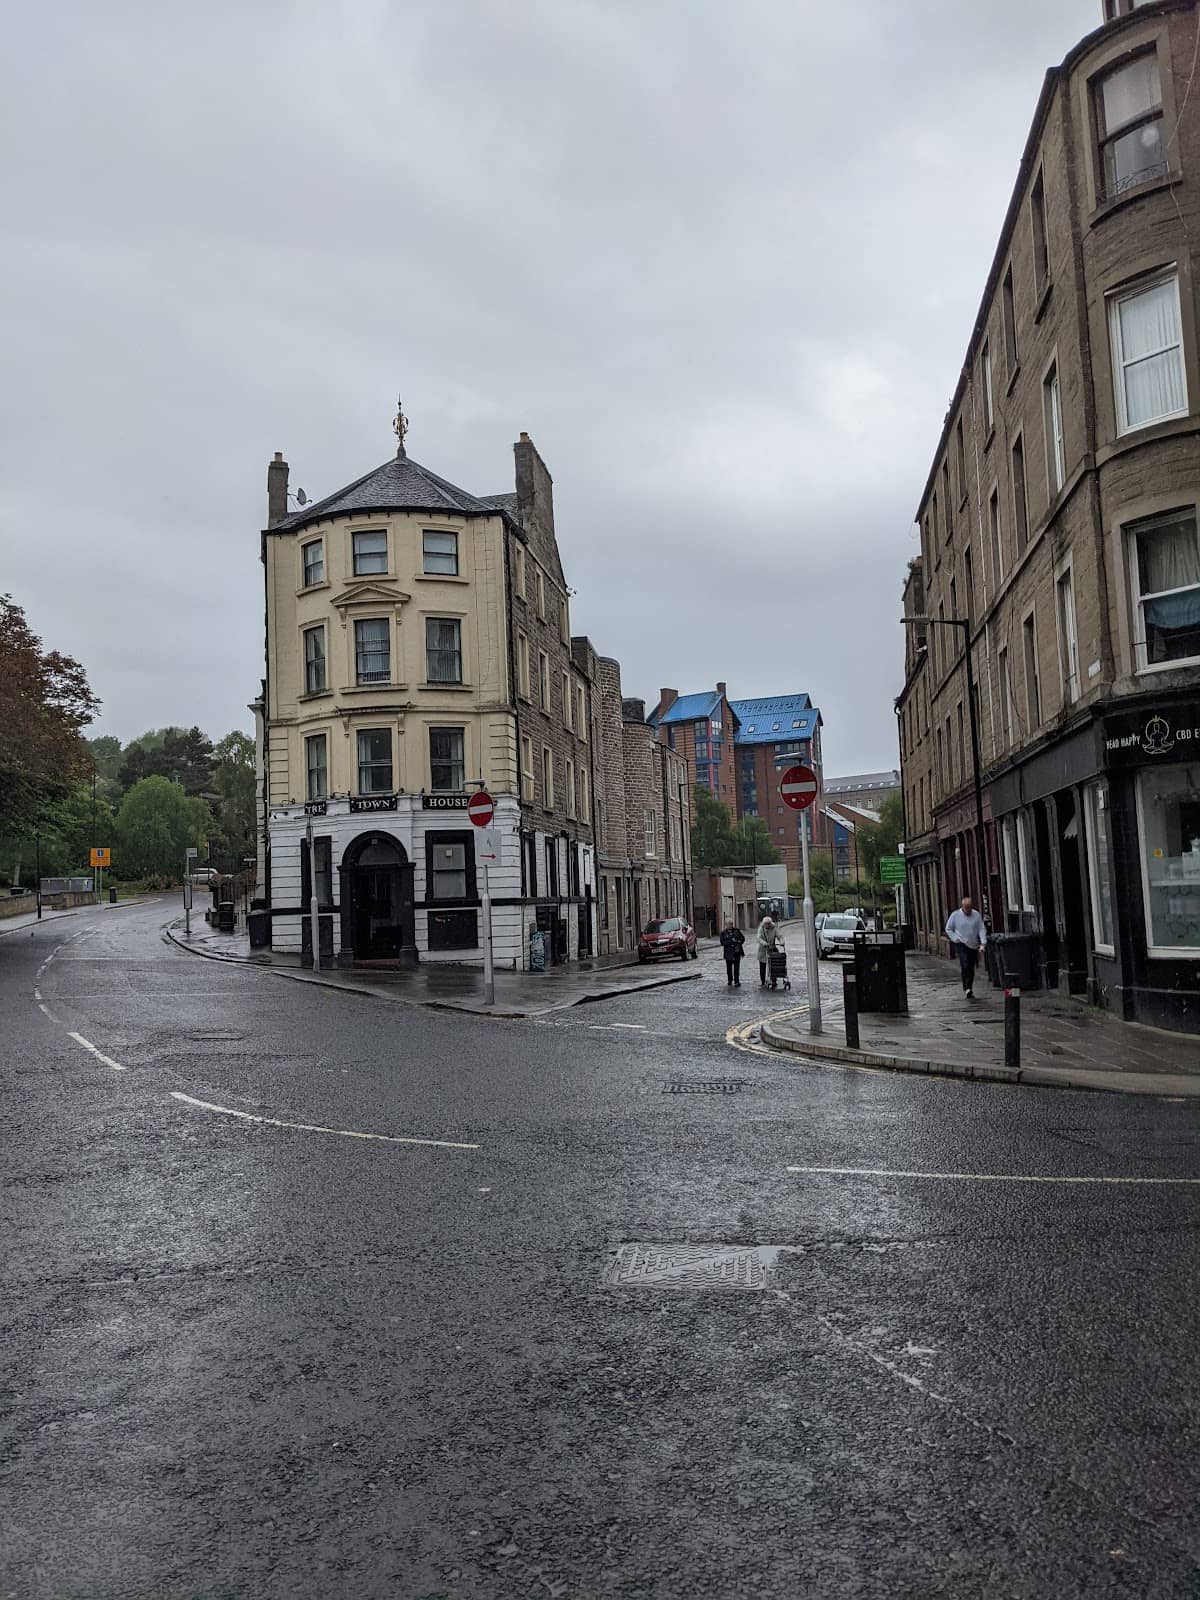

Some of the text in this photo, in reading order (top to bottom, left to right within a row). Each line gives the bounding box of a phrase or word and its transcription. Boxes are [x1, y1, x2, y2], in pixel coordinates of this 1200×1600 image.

[1120, 733, 1140, 747] HAPPY
[1176, 729, 1192, 740] CBD
[356, 799, 390, 809] TOWN
[429, 798, 468, 807] HOUSE
